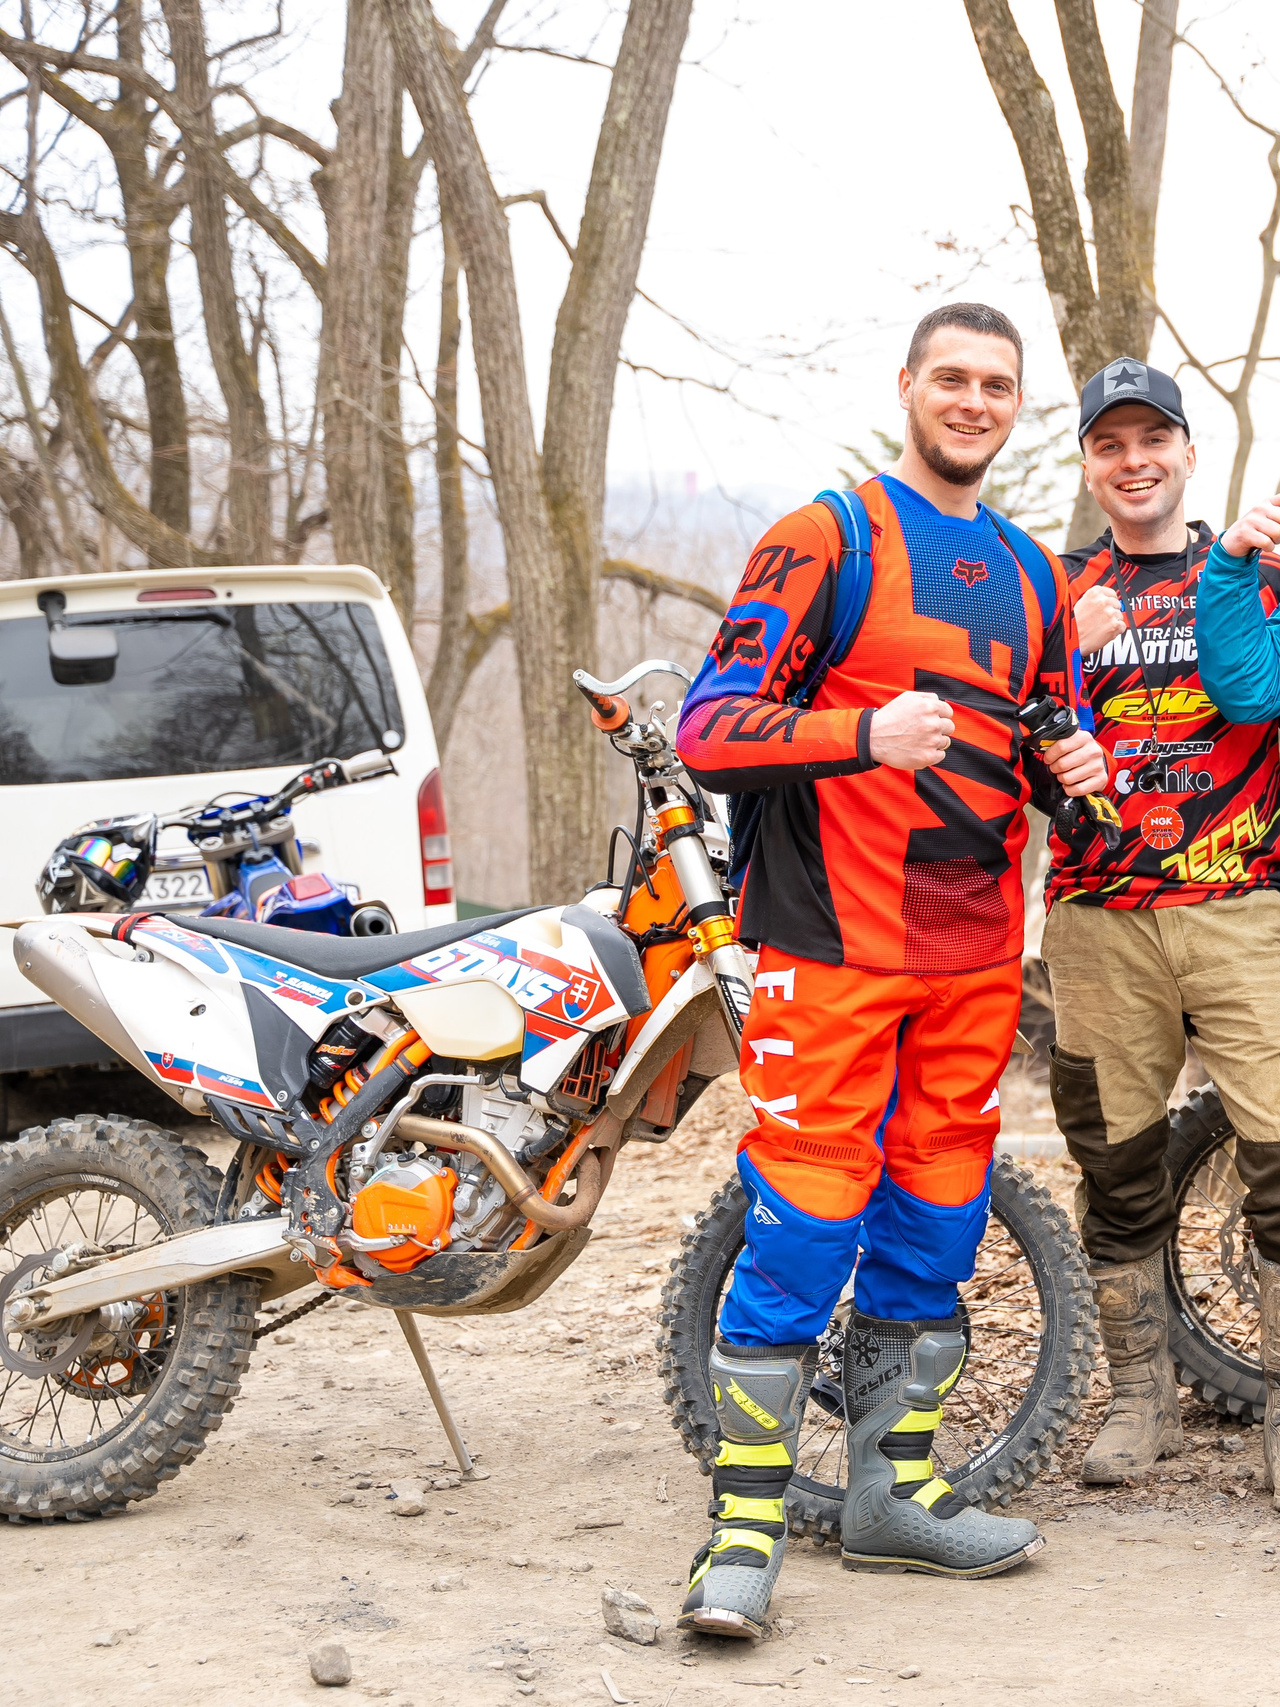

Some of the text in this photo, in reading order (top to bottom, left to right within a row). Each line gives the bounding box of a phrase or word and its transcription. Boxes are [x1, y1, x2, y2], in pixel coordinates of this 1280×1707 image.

[1144, 626, 1194, 641] TRANS
[1101, 629, 1198, 667] MOTOC
[698, 695, 813, 743] FOX
[1138, 763, 1214, 793] ehika
[1150, 816, 1173, 826] NGK
[473, 934, 501, 948] KTM
[218, 1074, 244, 1088] KTM
